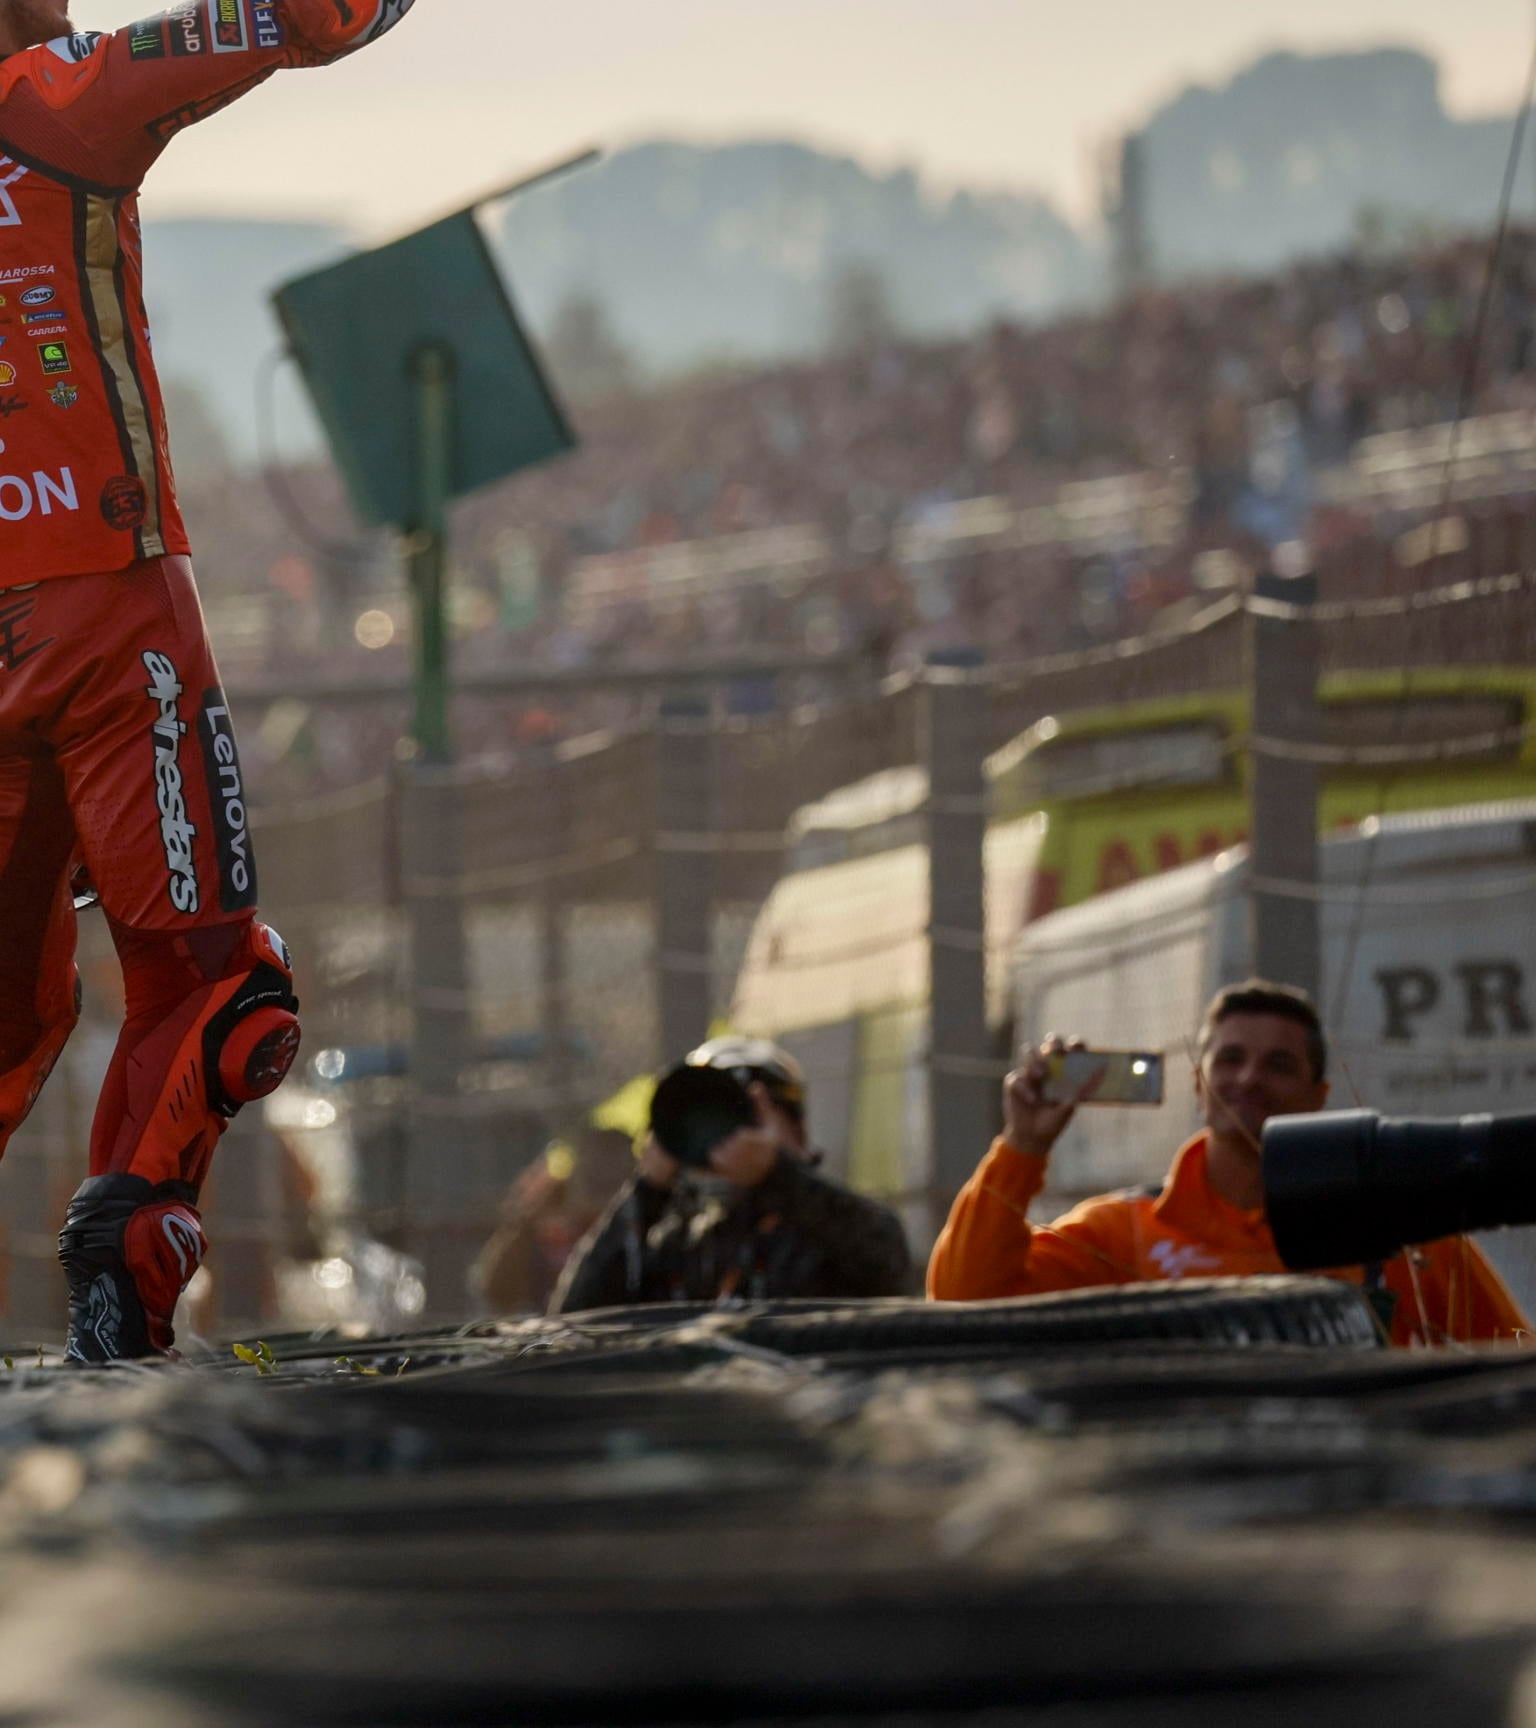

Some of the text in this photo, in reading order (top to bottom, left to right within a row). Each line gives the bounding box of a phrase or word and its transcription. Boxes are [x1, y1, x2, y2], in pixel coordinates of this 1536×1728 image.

[27, 325, 68, 337] CARRERA
[142, 650, 199, 913] alpinestars
[206, 705, 250, 893] Lenovo
